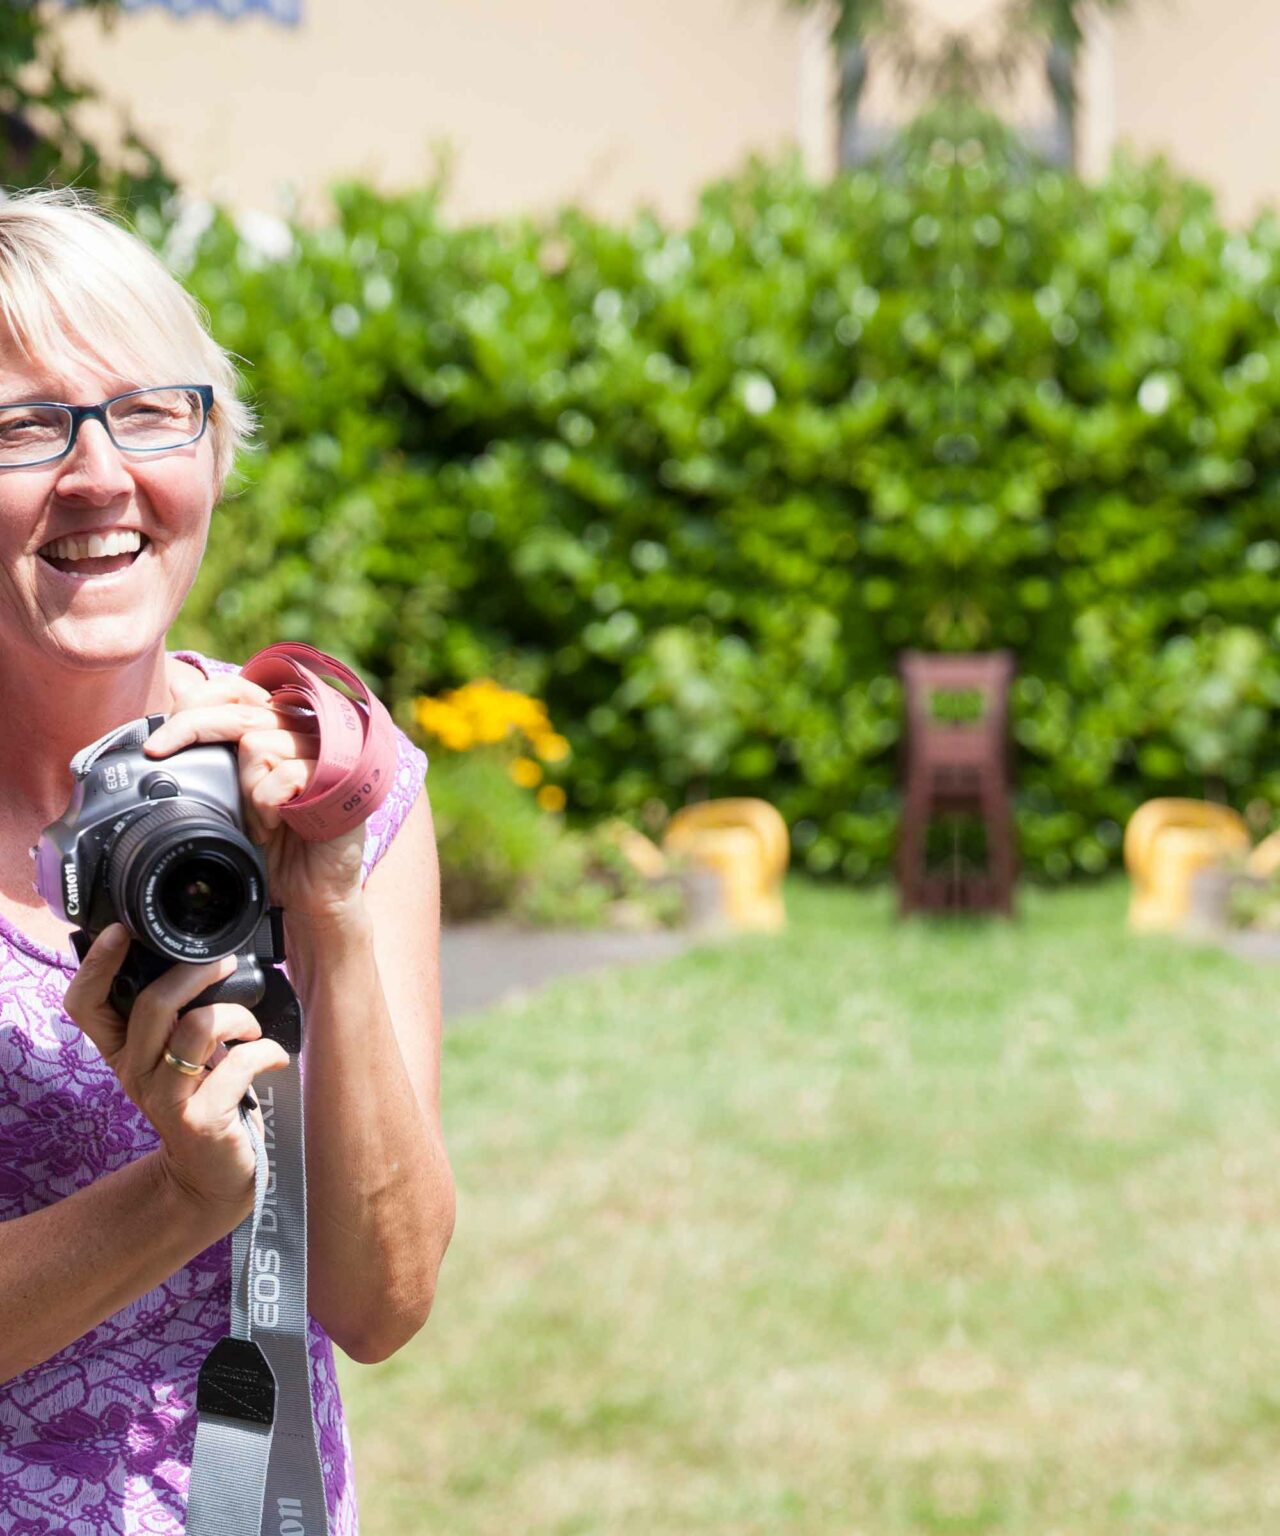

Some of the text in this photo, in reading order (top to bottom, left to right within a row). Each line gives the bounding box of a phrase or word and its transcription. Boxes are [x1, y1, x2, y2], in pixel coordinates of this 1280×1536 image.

[104, 766, 118, 790] EOS
[64, 863, 80, 916] Canon
[151, 921, 165, 937] LENS
[163, 936, 183, 951] ZOOM
[184, 946, 209, 955] CANON
[254, 1248, 281, 1327] EOS
